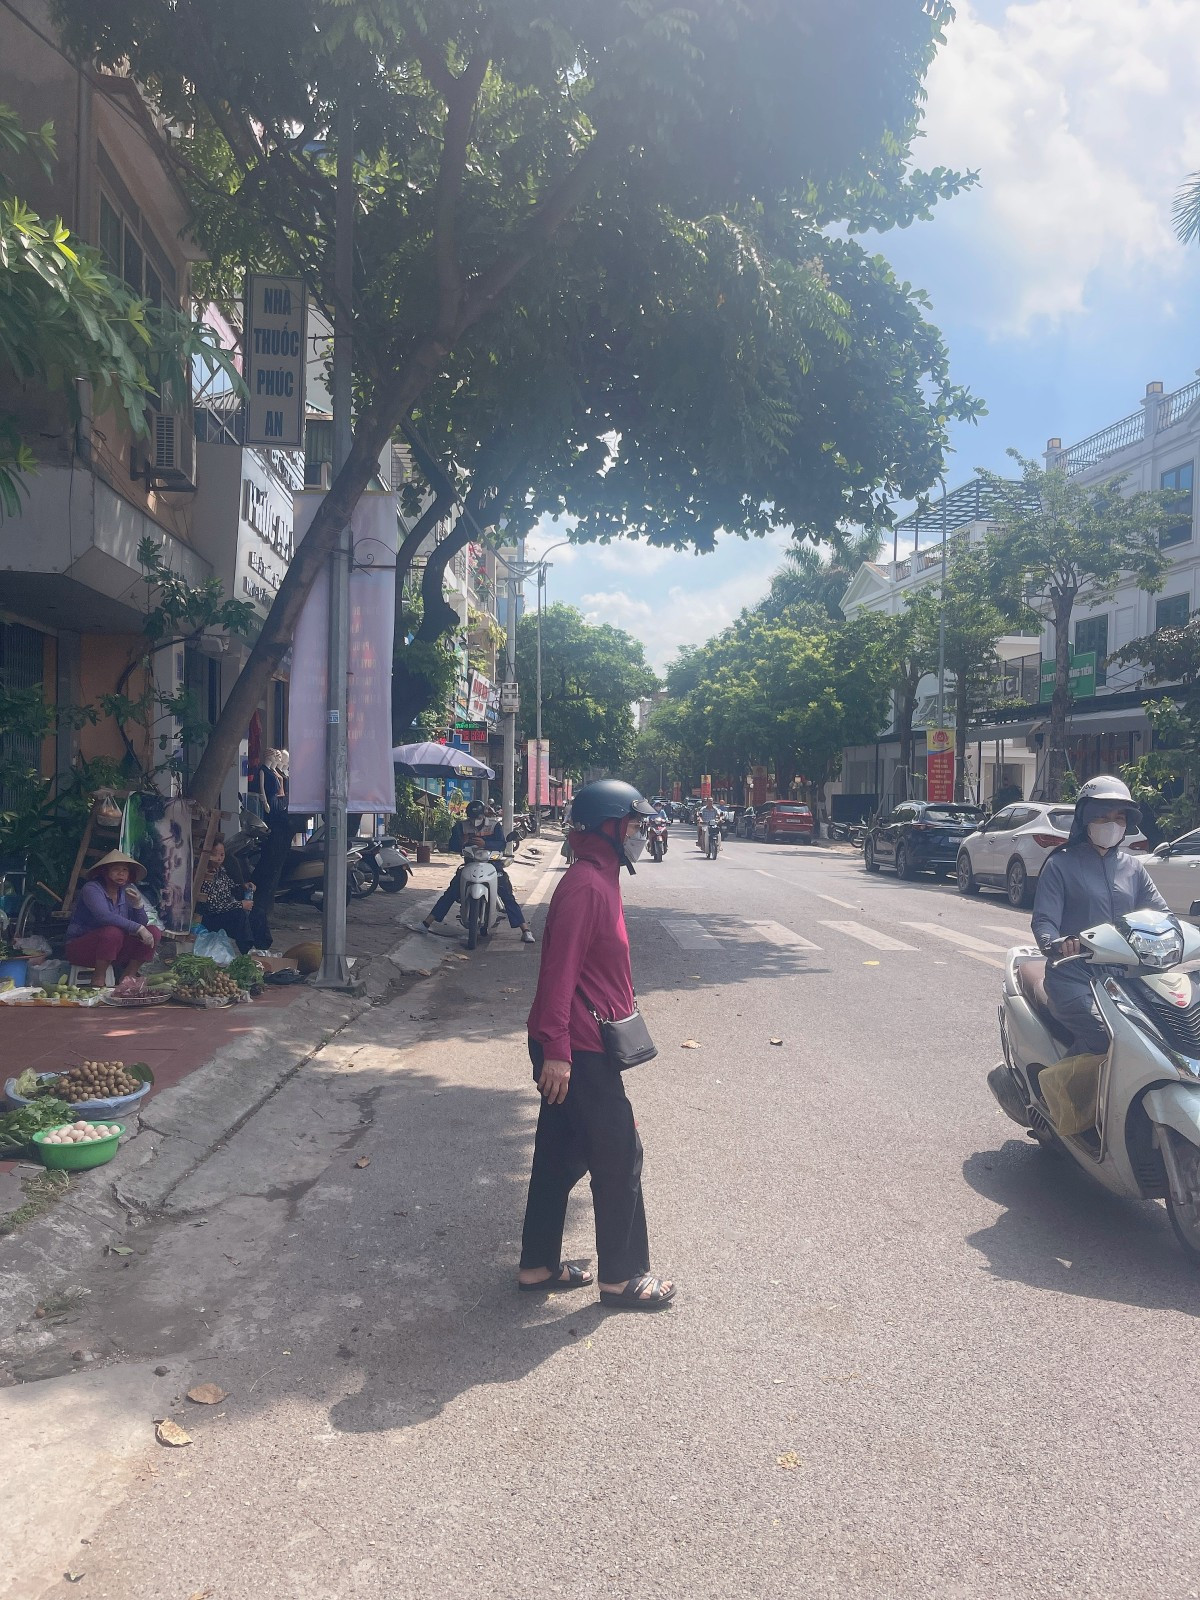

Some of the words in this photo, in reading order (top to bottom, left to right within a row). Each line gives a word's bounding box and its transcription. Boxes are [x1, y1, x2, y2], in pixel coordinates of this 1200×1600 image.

[253, 322, 299, 357] THUỐC
[256, 367, 294, 397] PHÚC
[264, 411, 284, 437] AN
